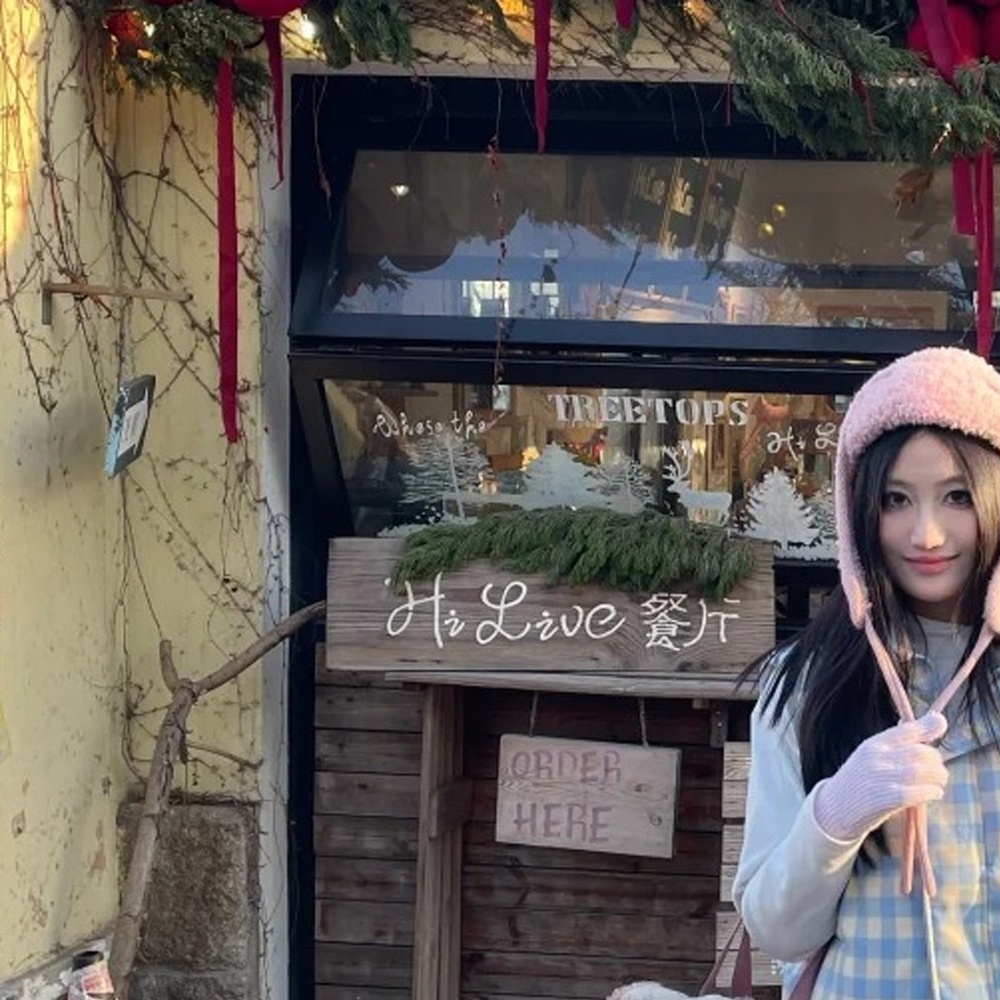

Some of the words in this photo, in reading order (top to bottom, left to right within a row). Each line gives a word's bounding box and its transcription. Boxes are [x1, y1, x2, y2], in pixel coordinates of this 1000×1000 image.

[548, 394, 748, 426] TREETOPS
[384, 571, 466, 648] Hi
[476, 581, 627, 645] Live
[641, 593, 740, 650] 餐厅
[511, 750, 622, 784] ORDER
[513, 802, 613, 842] HERE
